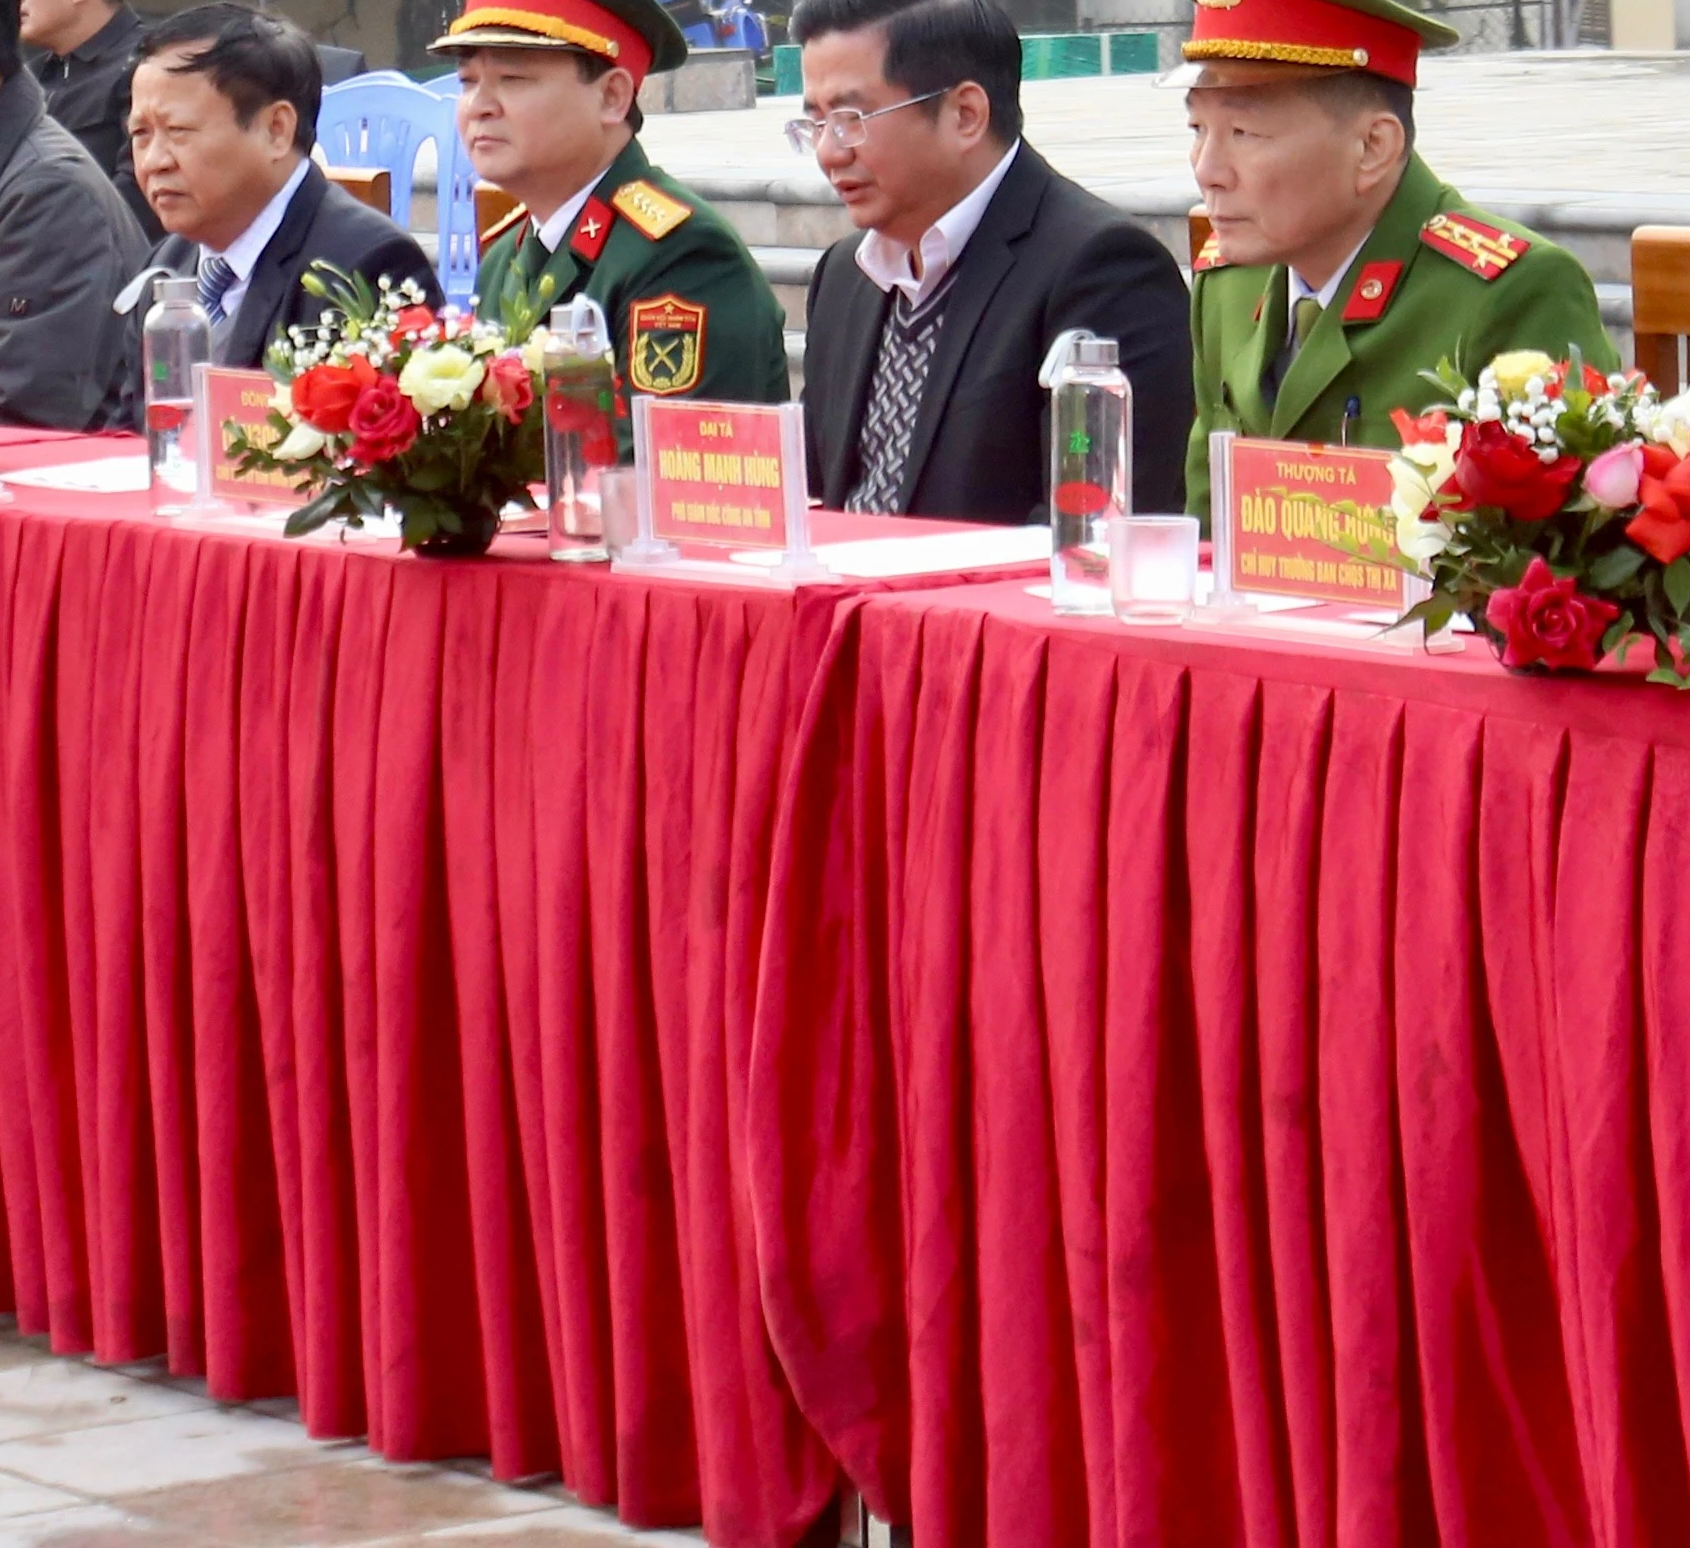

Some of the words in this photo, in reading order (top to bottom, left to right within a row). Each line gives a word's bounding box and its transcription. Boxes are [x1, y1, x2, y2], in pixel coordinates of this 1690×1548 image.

[1276, 461, 1335, 485] THƯỢNG
[1338, 465, 1357, 485] TÁ
[1240, 487, 1276, 535] ĐÀO
